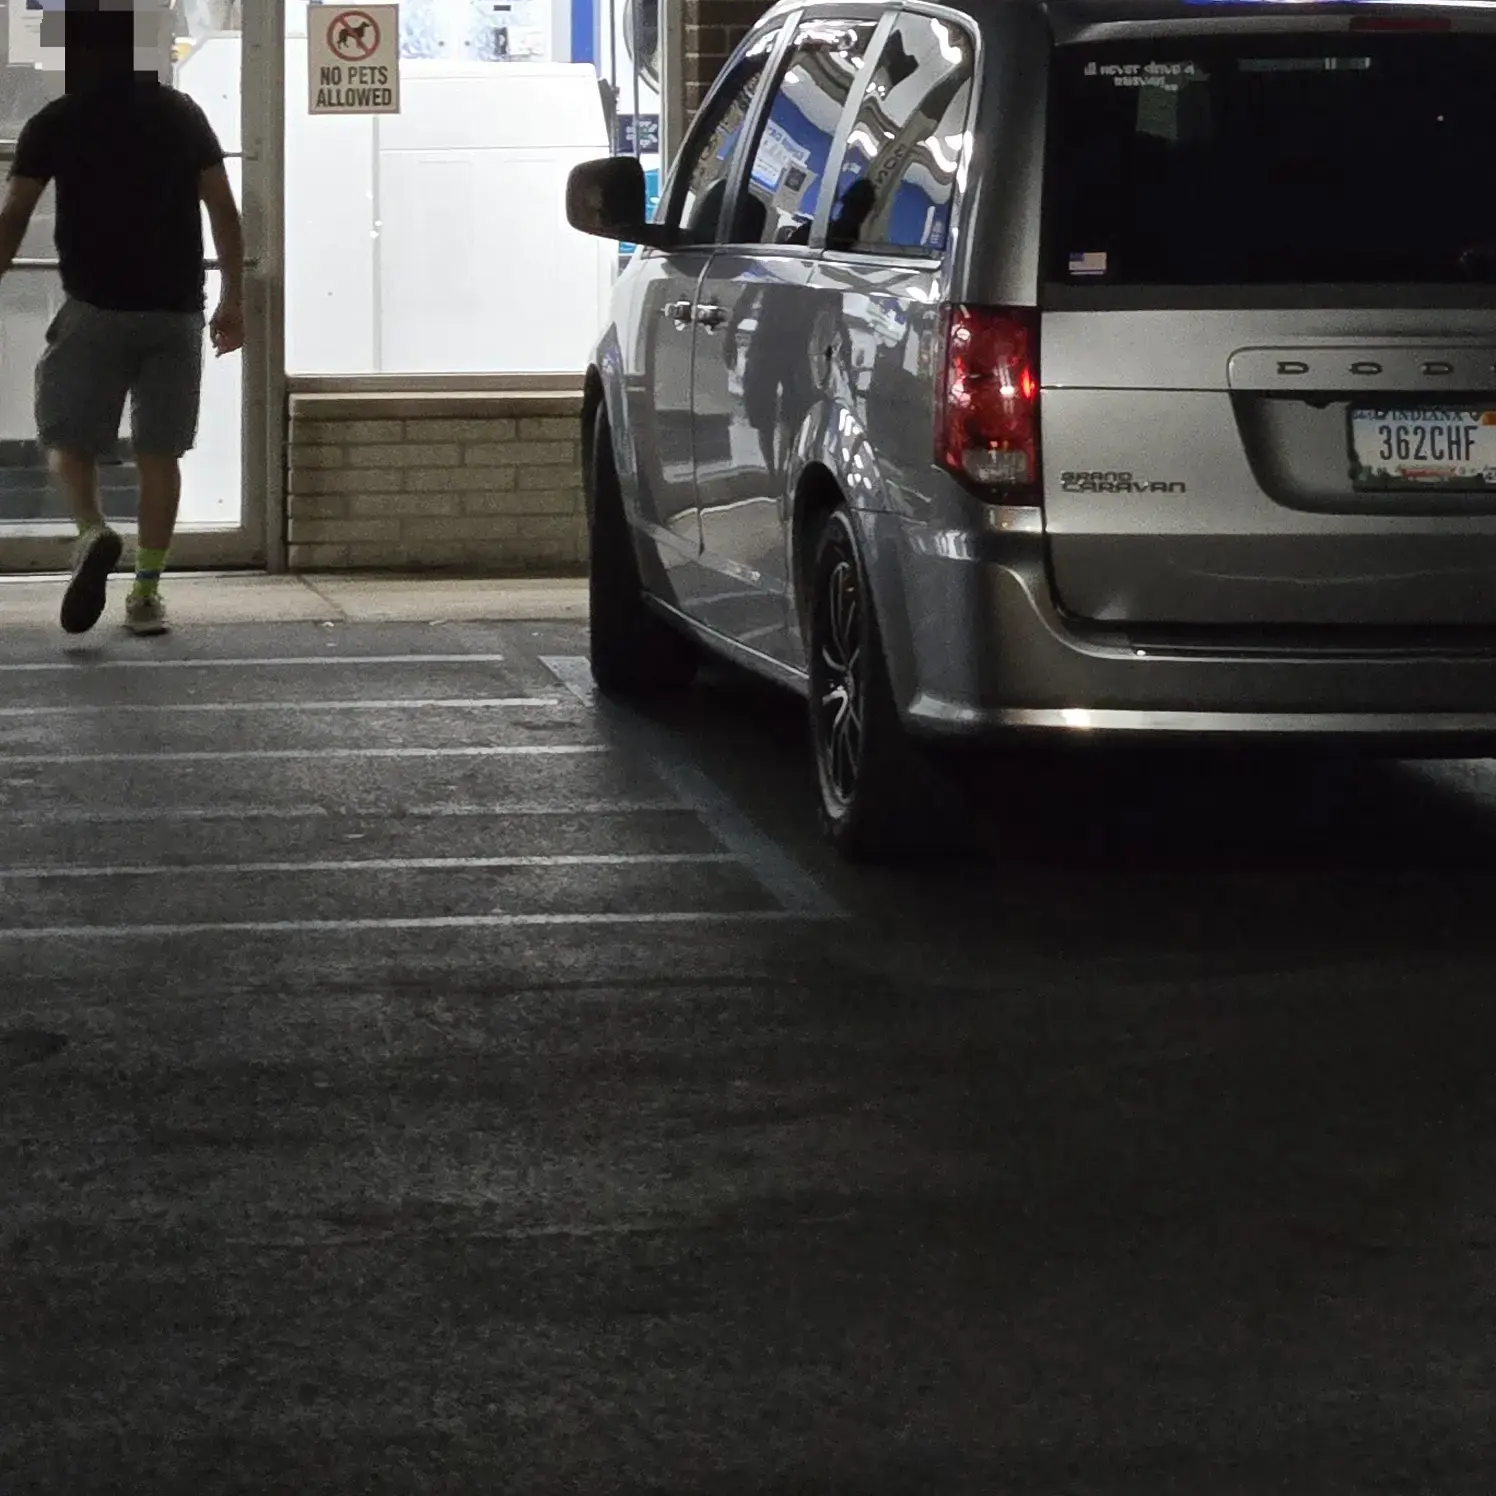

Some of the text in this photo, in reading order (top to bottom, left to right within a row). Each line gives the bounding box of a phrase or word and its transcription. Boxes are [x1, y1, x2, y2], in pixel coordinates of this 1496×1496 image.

[320, 65, 388, 85] NO PETS
[316, 87, 392, 107] ALLOWED
[1378, 425, 1479, 461] 362CHF
[1061, 471, 1133, 481] GRAND
[1061, 481, 1187, 493] CARAVAN
